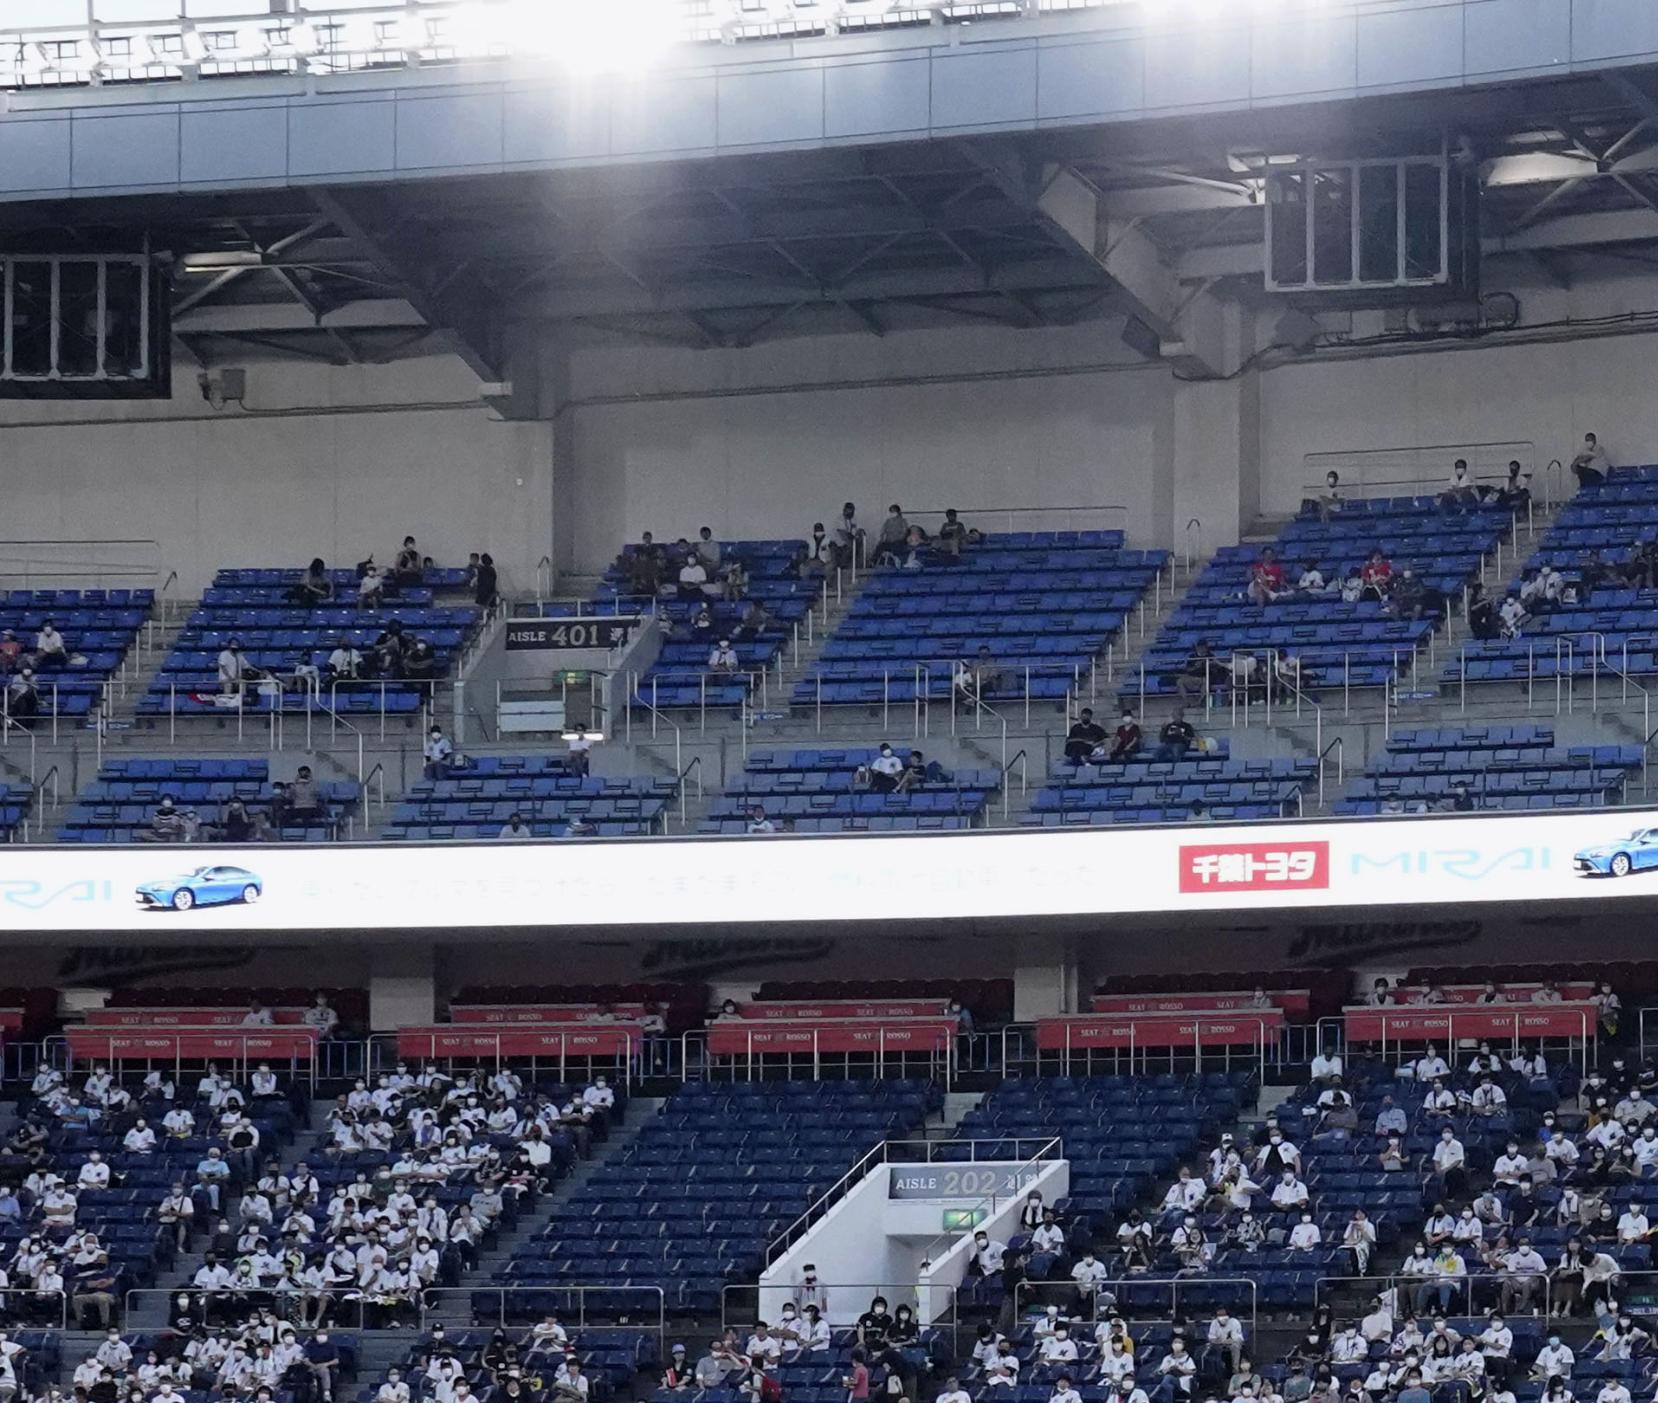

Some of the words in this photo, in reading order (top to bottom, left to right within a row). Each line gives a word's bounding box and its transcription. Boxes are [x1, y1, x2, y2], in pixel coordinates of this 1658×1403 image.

[508, 631, 546, 642] AISLE
[552, 625, 598, 646] 401
[1192, 851, 1316, 884] 千葉トヨタ
[895, 1178, 937, 1190] AISLE
[943, 1171, 996, 1194] 202
